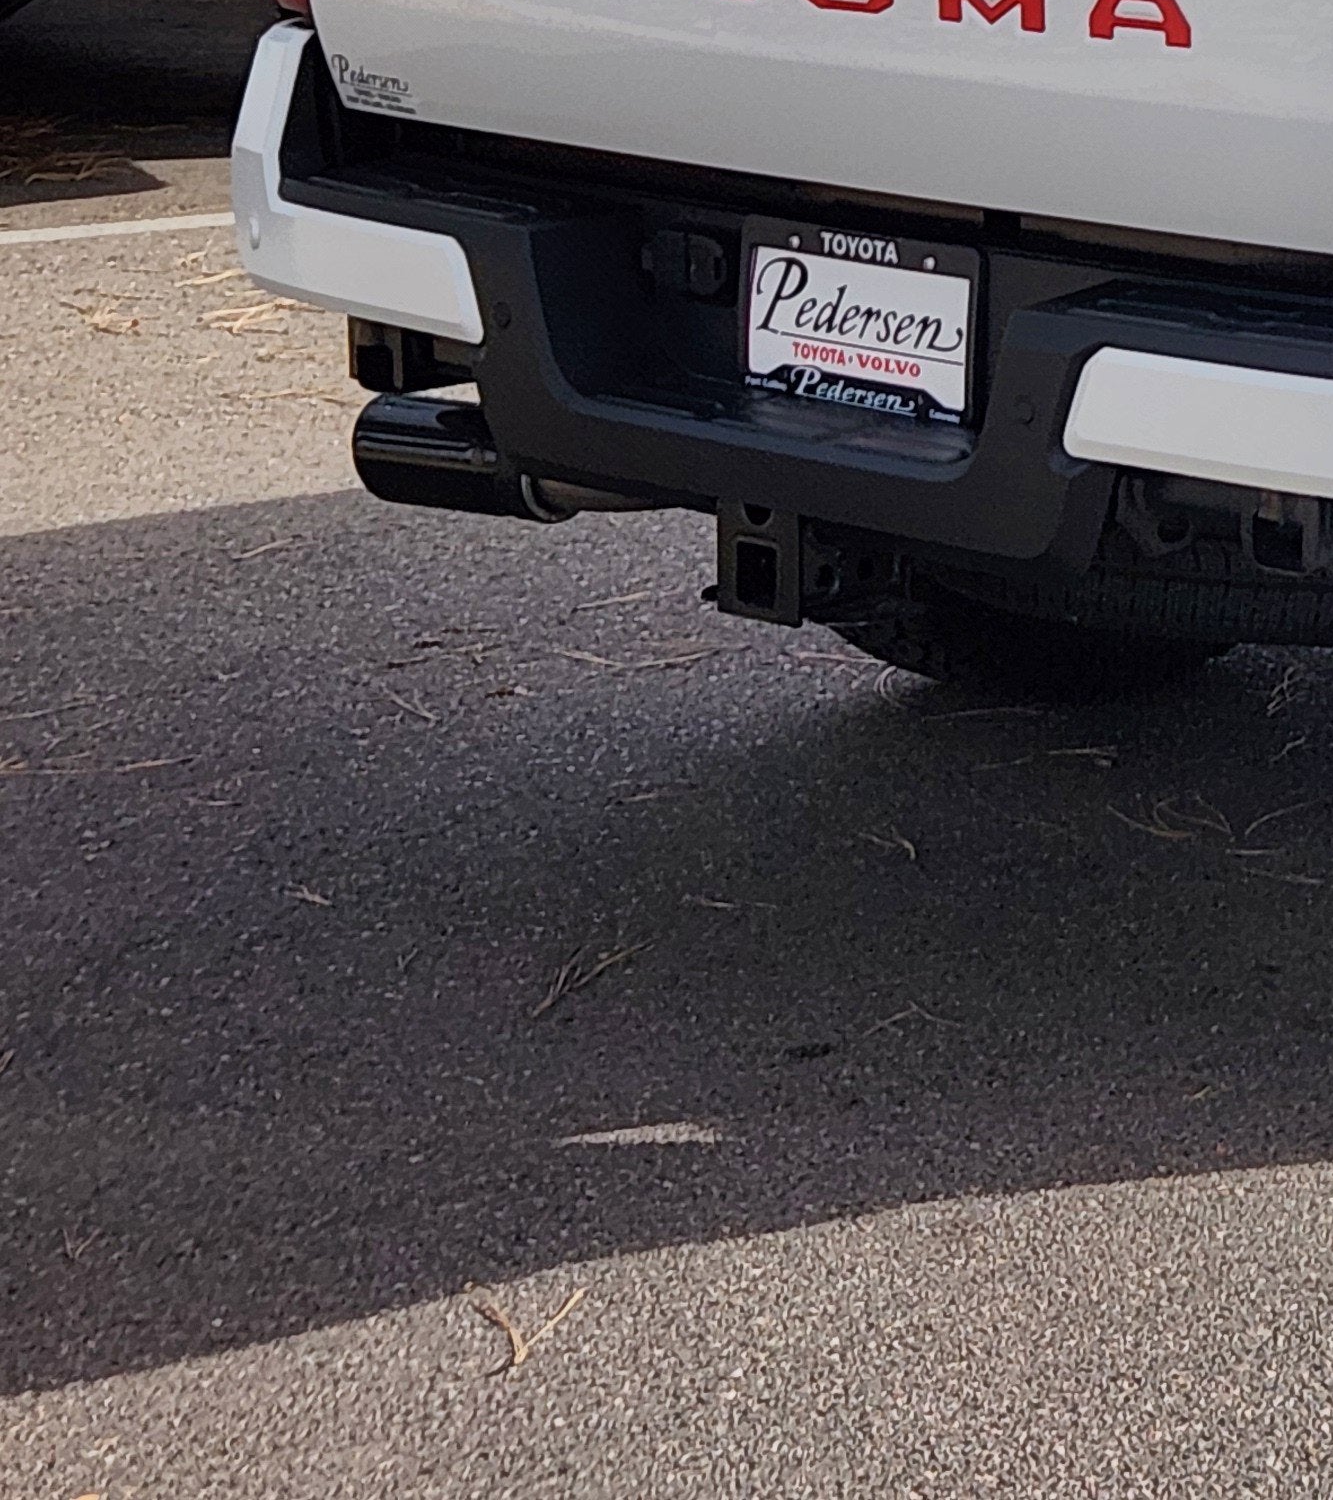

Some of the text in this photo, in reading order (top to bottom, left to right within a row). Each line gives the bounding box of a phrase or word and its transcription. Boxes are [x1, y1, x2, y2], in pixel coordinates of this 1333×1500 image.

[820, 231, 899, 264] TOYOTA
[756, 257, 963, 352] Pedersen
[792, 341, 921, 378] TOYOTA VOLVO
[790, 366, 916, 414] Pedersen
